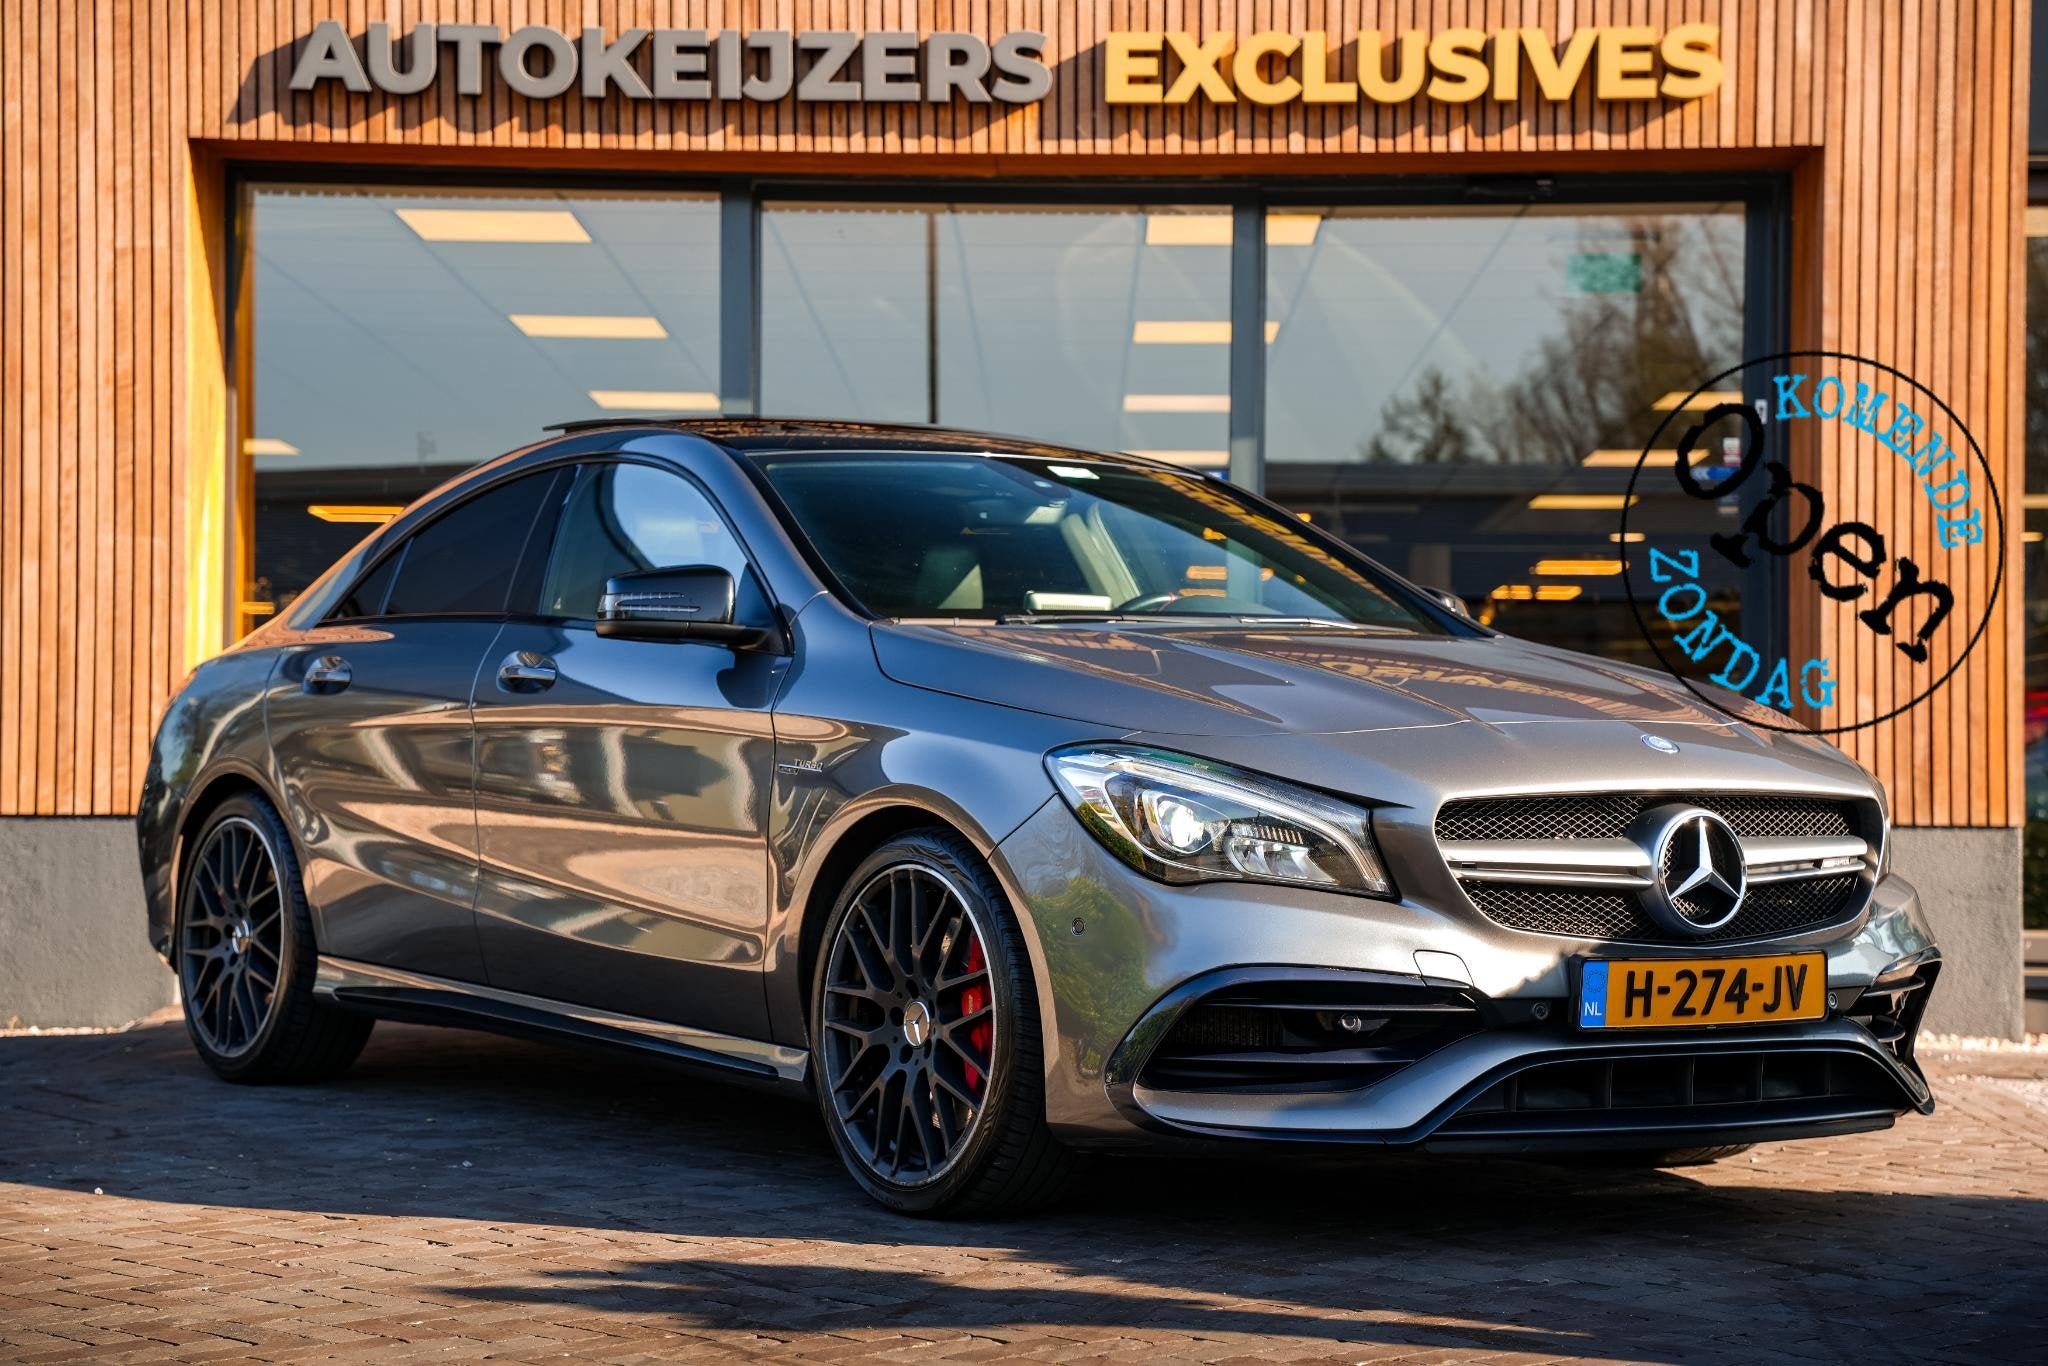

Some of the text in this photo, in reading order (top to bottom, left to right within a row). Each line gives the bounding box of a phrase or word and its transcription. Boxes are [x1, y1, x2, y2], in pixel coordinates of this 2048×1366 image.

[290, 20, 1723, 104] AUTOKEIJZERS EXCLUSIVES
[1584, 1001, 1602, 1017] NL
[1624, 963, 1808, 1018] H-274-JV
